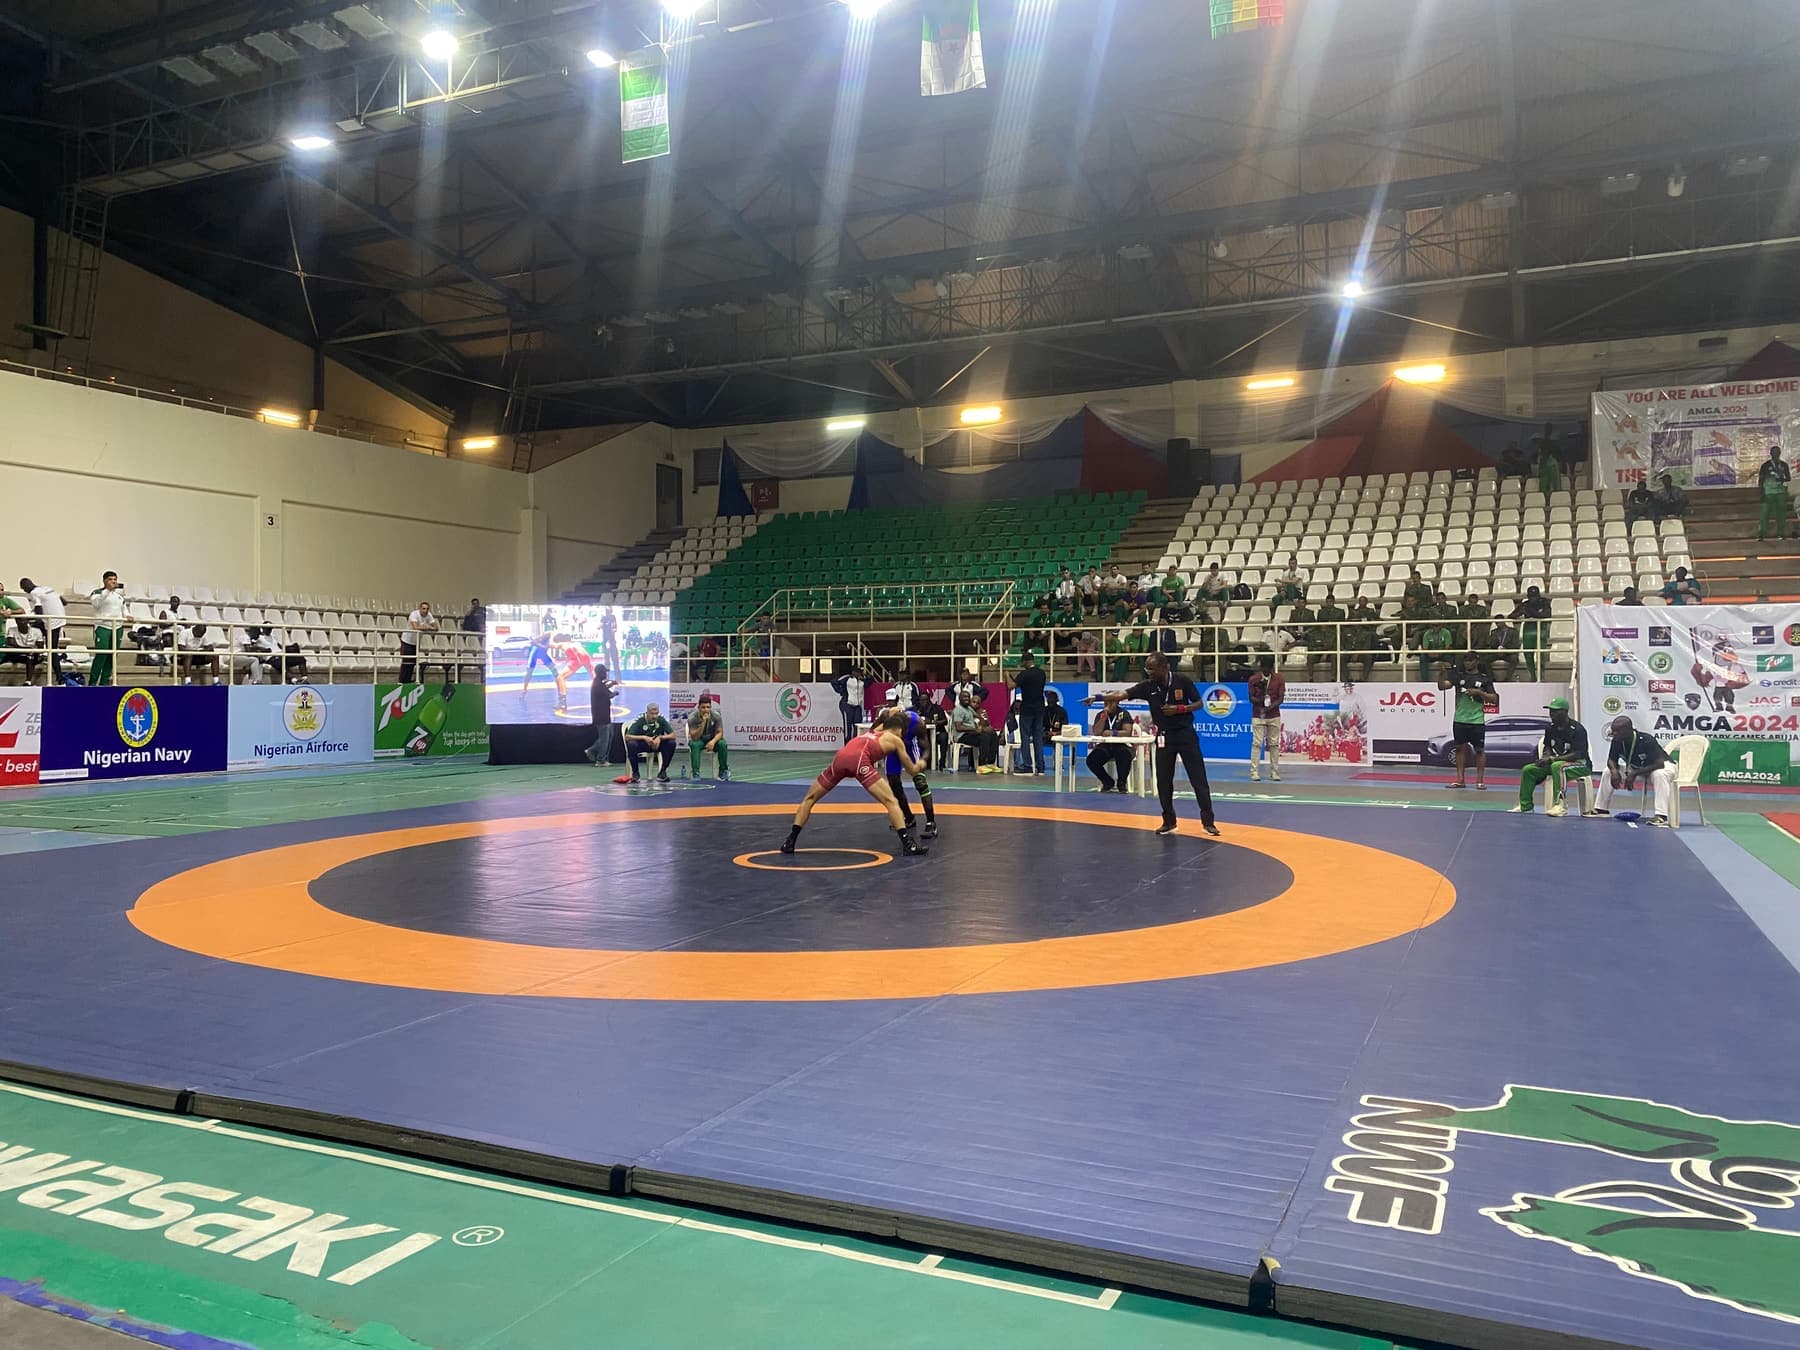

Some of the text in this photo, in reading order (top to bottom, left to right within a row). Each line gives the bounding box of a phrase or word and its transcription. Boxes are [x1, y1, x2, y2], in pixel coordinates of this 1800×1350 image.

[1626, 380, 1799, 404] YOU ARE ALL WELCOME
[1687, 407, 1721, 416] AMGA
[267, 516, 274, 526] 3
[1380, 692, 1436, 706] JAC
[1749, 696, 1781, 704] JAC
[797, 726, 844, 734] DEVELOPMEN
[1654, 714, 1799, 732] AMGA2024
[748, 734, 782, 742] COMPANY
[794, 734, 822, 742] NIGERIA
[254, 740, 349, 759] Nigerian Airforce
[83, 747, 192, 768] Nigerian Navy
[1740, 751, 1754, 769] 1
[5, 758, 38, 773] best
[1718, 771, 1781, 781] AMGA2024
